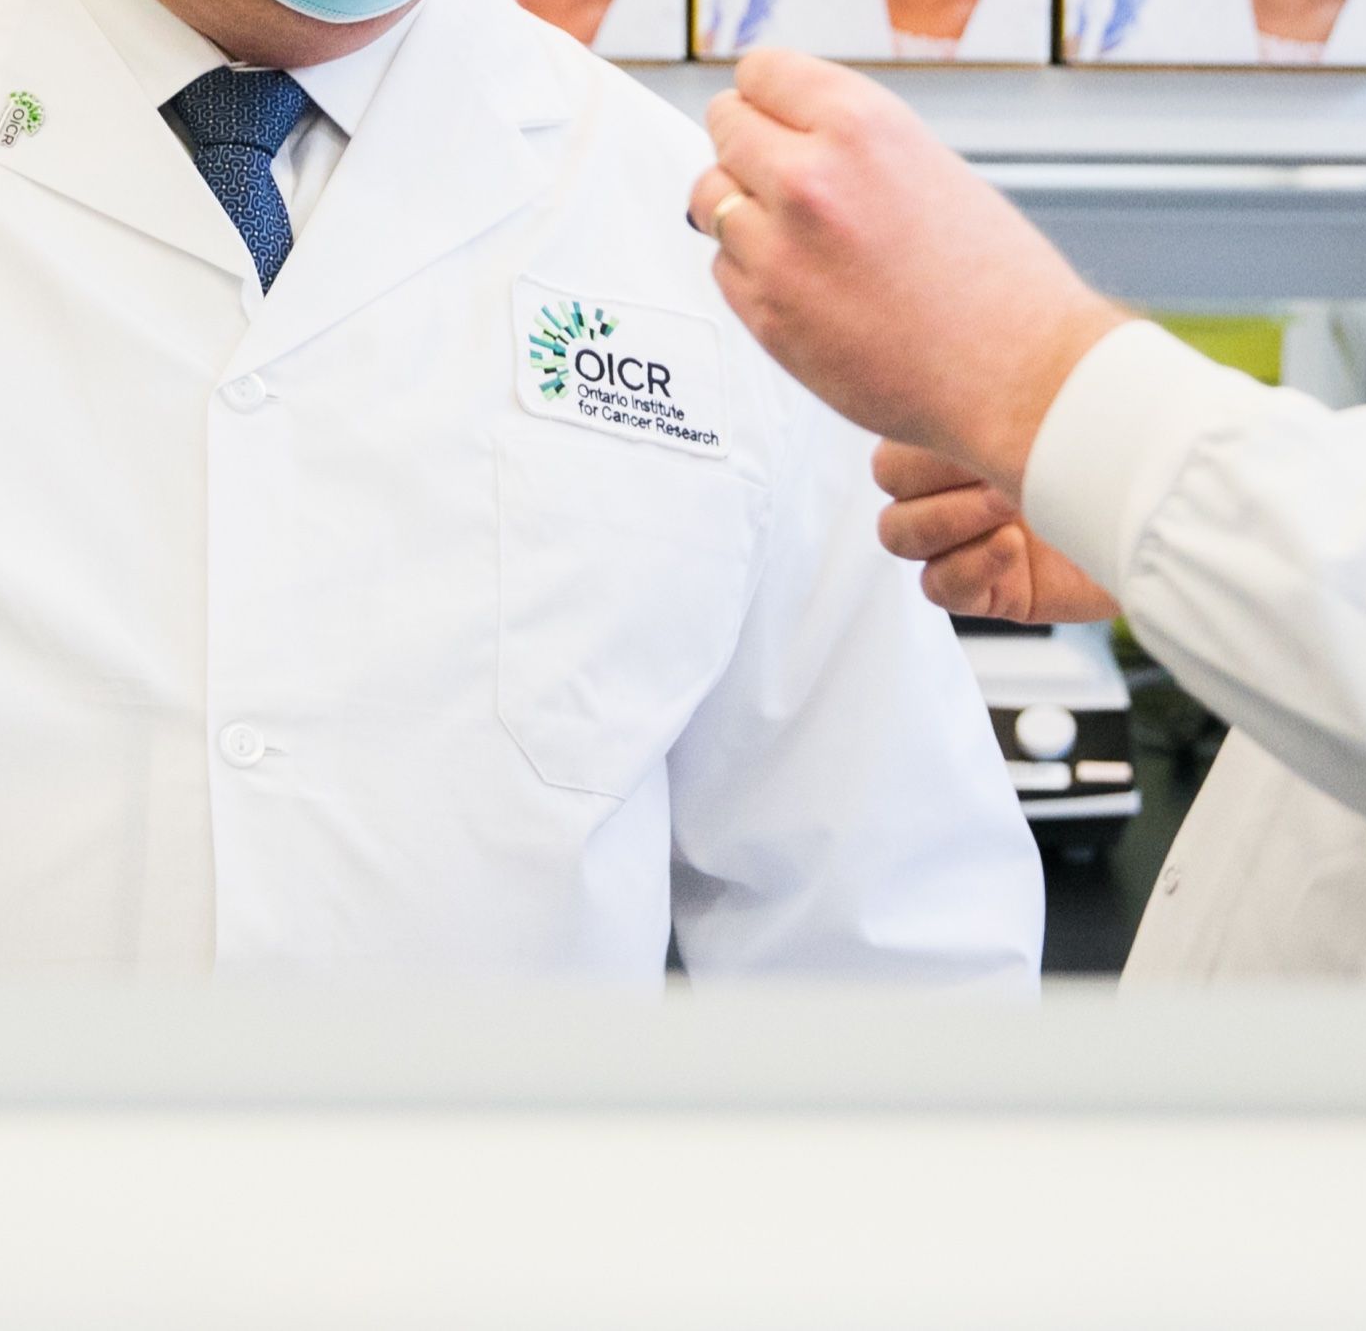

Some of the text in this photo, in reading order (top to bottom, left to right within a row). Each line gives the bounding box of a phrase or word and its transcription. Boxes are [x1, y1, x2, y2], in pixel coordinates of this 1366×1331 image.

[1, 108, 25, 145] OICR
[575, 348, 672, 398] OICR
[577, 383, 685, 421] Ontario Institute
[578, 400, 720, 447] for Cancer Research
